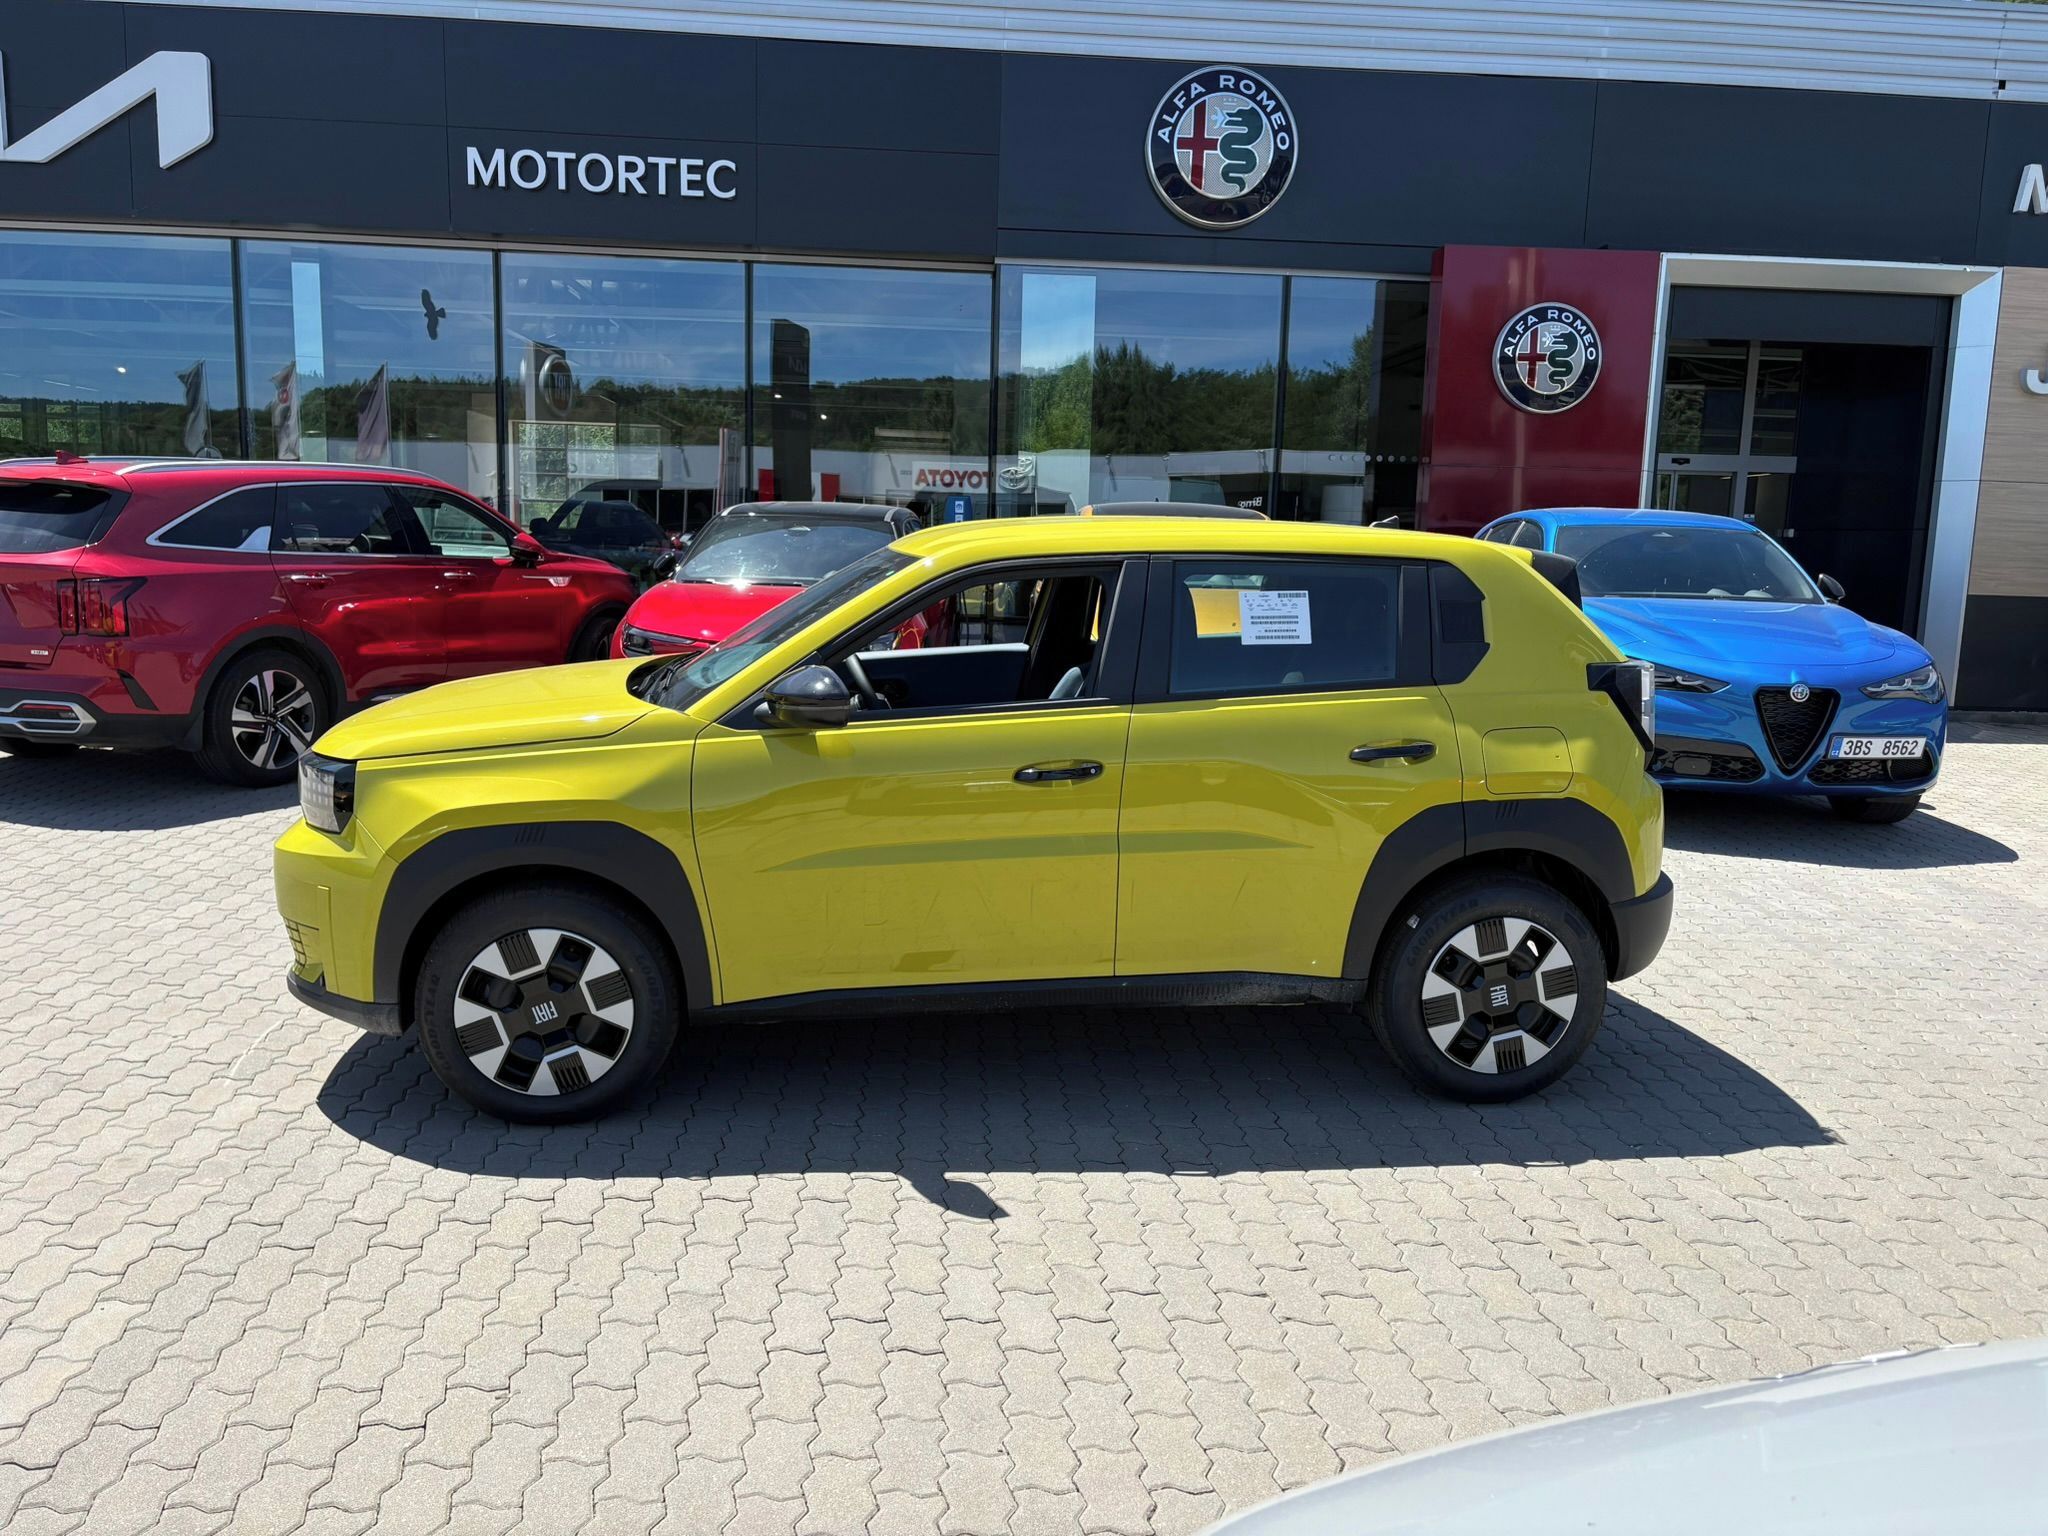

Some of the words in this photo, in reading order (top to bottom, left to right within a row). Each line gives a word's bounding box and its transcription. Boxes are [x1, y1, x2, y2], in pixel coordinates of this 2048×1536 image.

[1157, 81, 1207, 144] ALFA
[1219, 74, 1290, 150] ROMEO
[465, 146, 738, 200] MOTORTEC
[1503, 314, 1539, 358] ALFA
[1547, 309, 1597, 361] ROMEO
[1843, 739, 1873, 756] 3BS
[1881, 739, 1920, 756] 8562
[531, 1000, 559, 1025] FIAT
[1490, 984, 1510, 1008] FIAT
